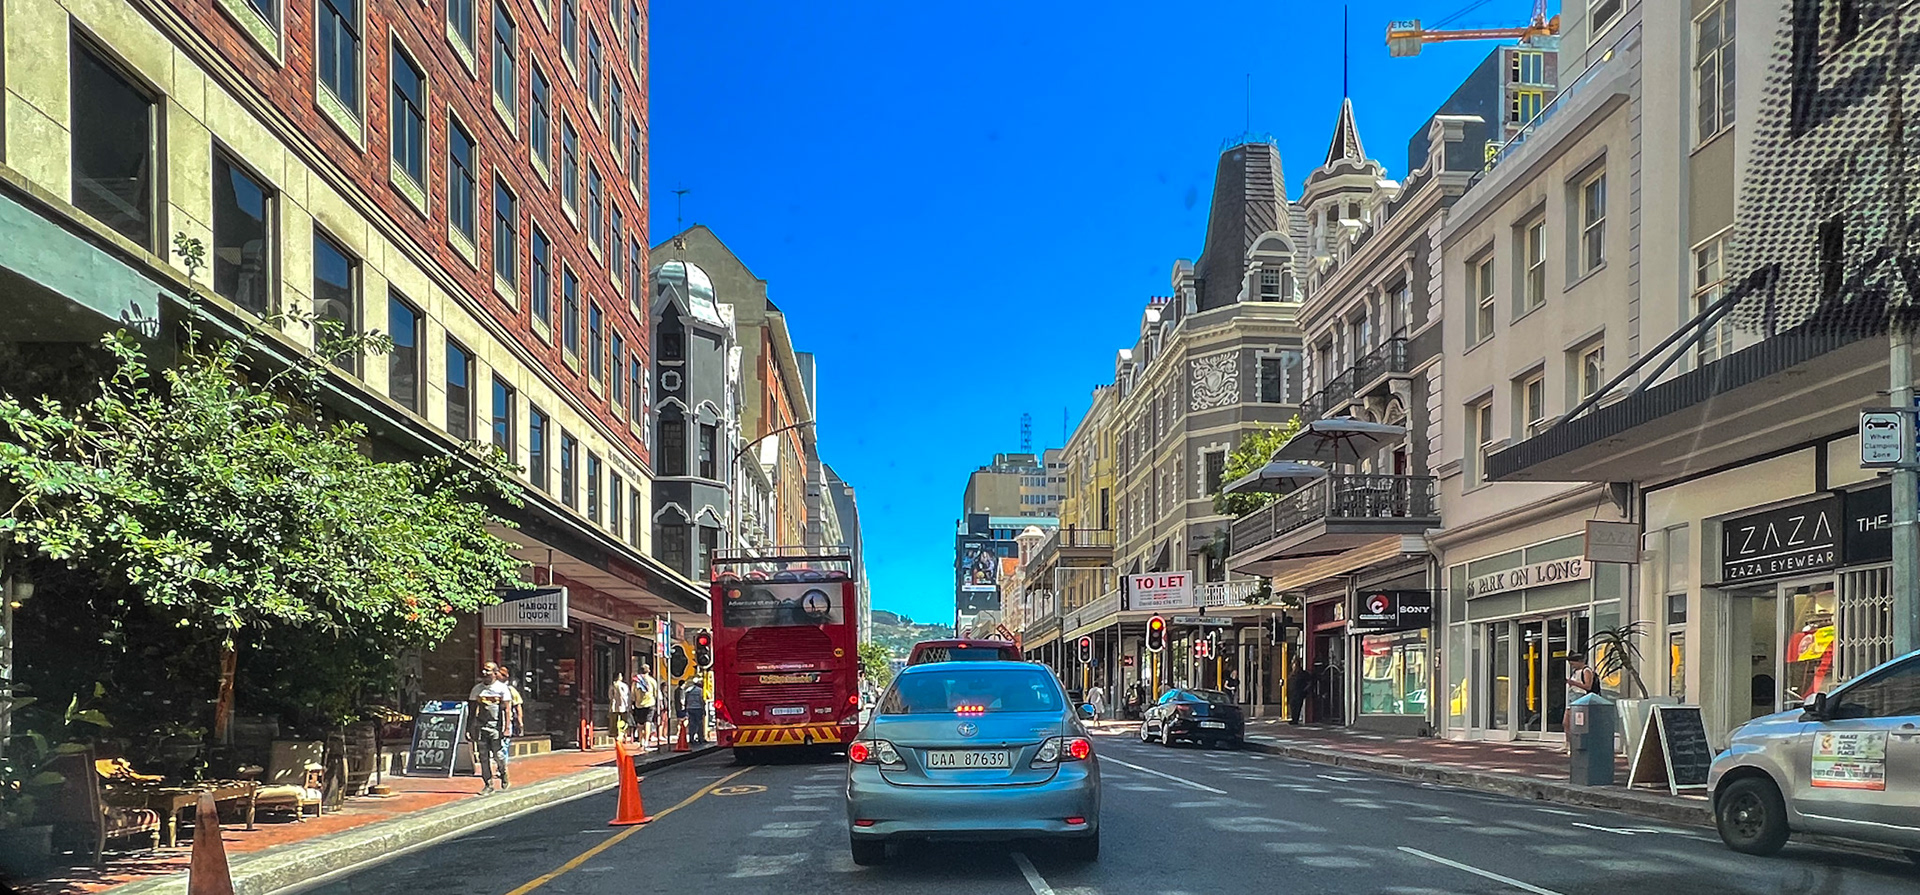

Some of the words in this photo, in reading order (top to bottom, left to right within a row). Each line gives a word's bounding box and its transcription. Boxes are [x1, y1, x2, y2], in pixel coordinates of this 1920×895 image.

[1857, 514, 1888, 532] THE
[1726, 511, 1833, 557] IZAZA
[1725, 566, 1763, 578] IZAZA
[1771, 551, 1834, 572] EYEWEAR
[1136, 578, 1154, 589] TO
[1159, 576, 1184, 588] LET
[1479, 573, 1504, 594] PARK
[1511, 568, 1529, 587] ON
[1536, 559, 1582, 583] LONG
[519, 602, 558, 610] MABOOZE
[519, 611, 550, 620] LIQUOR
[416, 750, 445, 765] R40
[931, 753, 956, 766] CAA
[964, 752, 1005, 765] 87639
